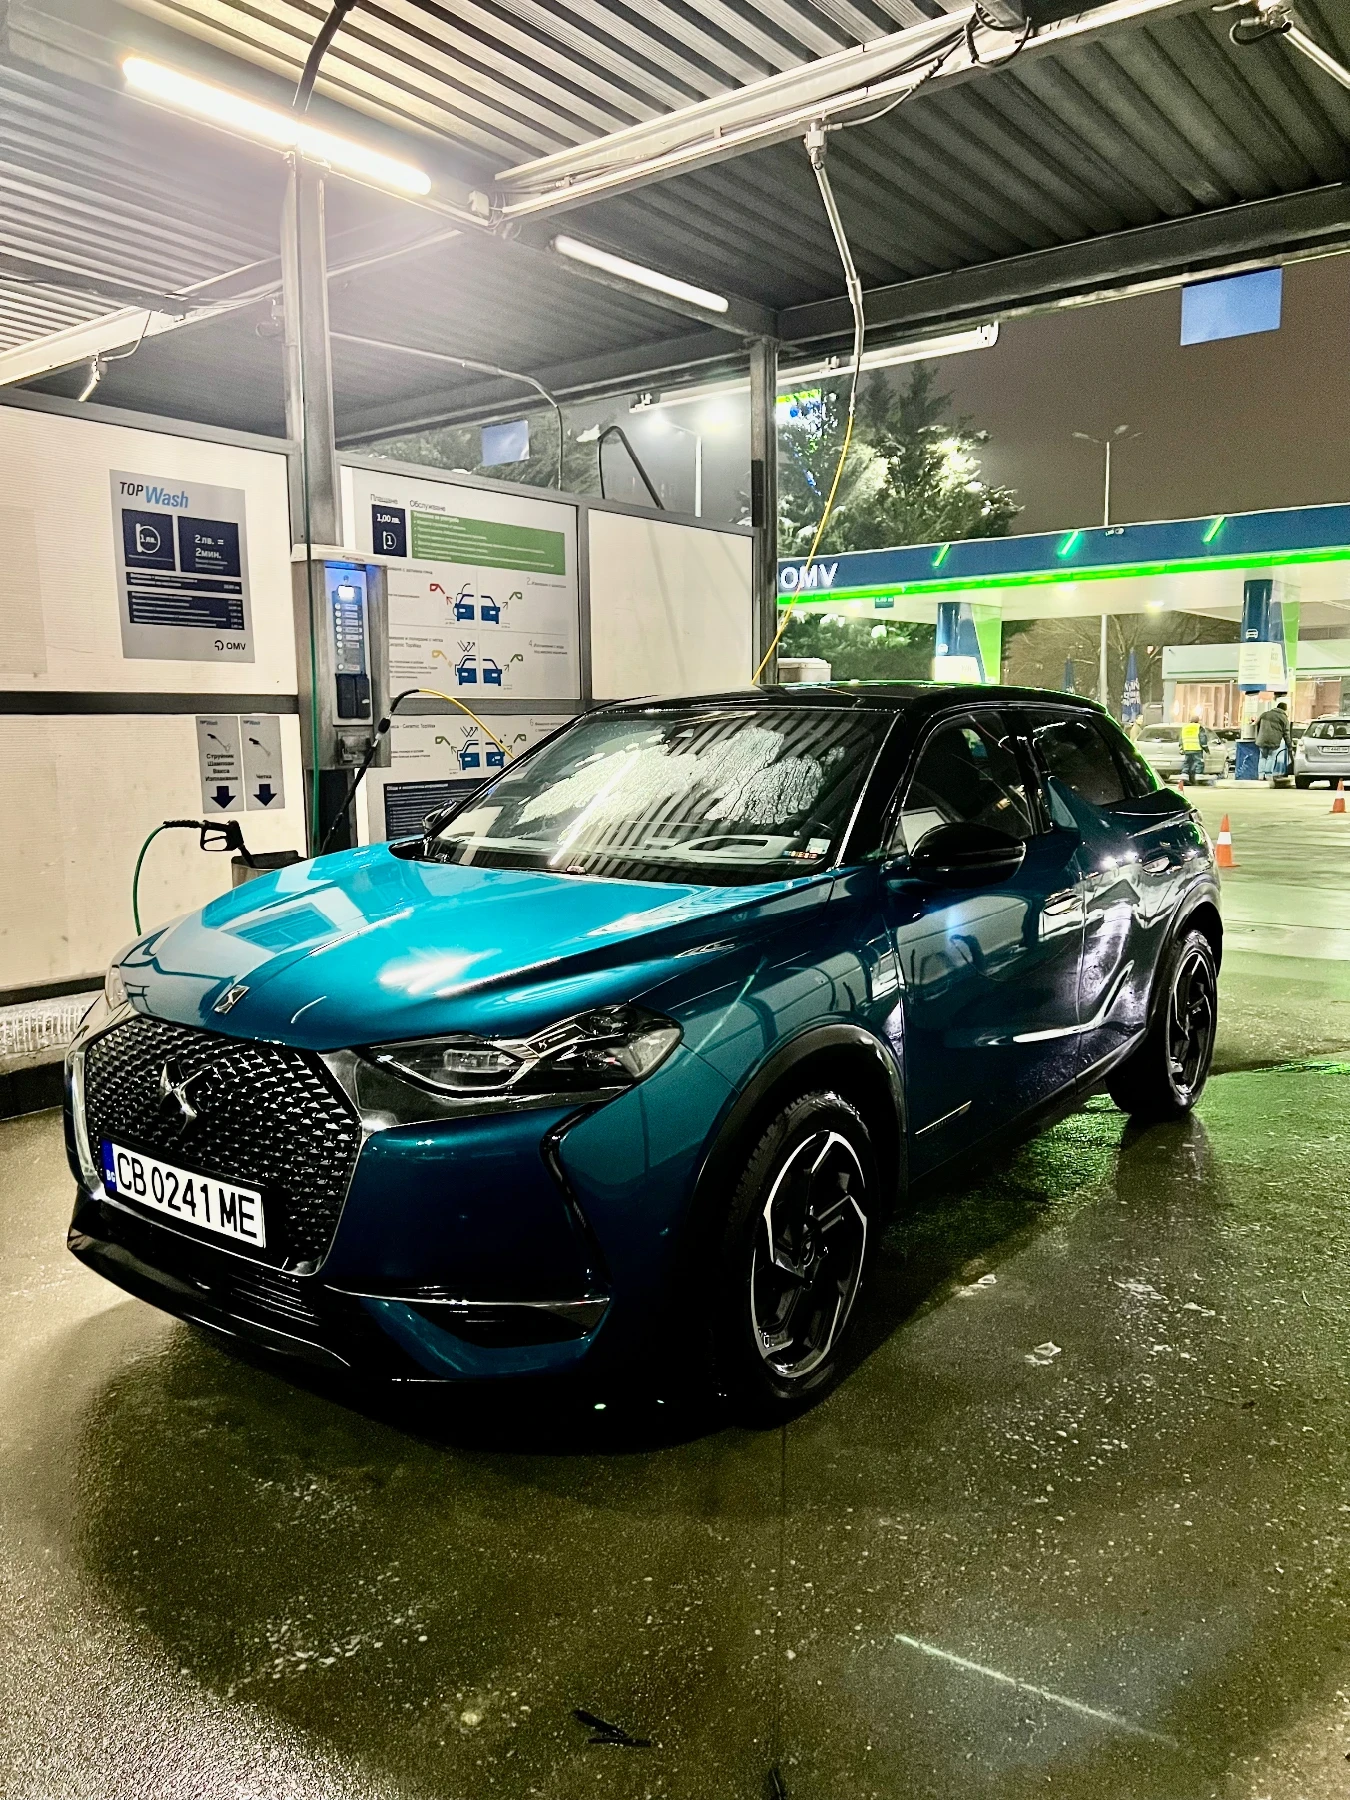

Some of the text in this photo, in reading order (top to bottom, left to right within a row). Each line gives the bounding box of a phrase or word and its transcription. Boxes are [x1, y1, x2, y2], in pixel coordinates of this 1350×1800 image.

[120, 482, 189, 508] TOP Wash
[780, 563, 838, 588] OMV
[226, 643, 246, 651] OMV
[106, 1169, 116, 1183] BG
[117, 1152, 258, 1239] CB 0241 ME
